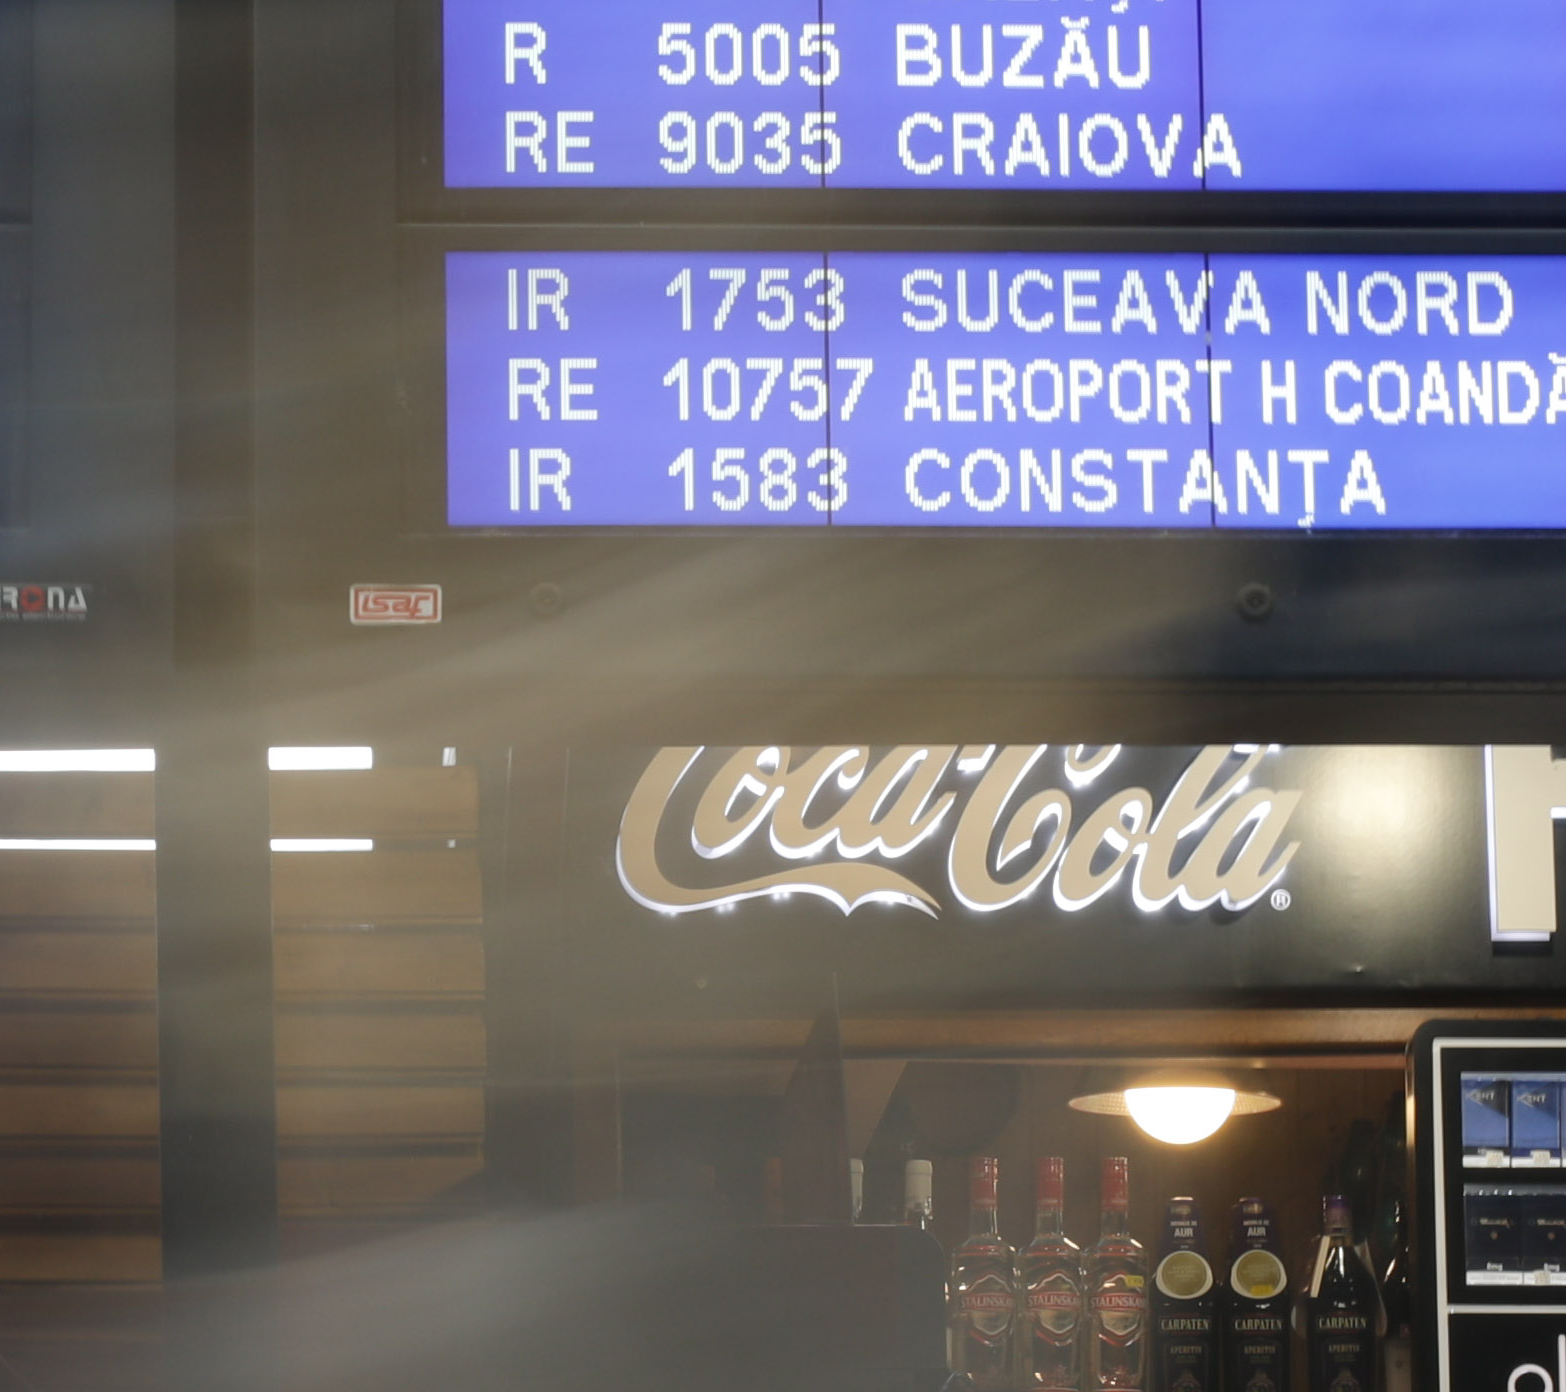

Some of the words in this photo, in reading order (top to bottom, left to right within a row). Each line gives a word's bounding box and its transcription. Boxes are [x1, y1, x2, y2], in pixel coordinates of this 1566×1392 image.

[505, 111, 594, 173] RE
[659, 111, 841, 175] 9035
[898, 112, 1242, 177] CRAIOVA
[508, 268, 569, 331] IR
[666, 268, 845, 331] 1753
[902, 269, 1270, 334] SUCEAVA
[1306, 271, 1513, 335] NORD
[509, 448, 571, 511] IR
[668, 447, 848, 512] 1583
